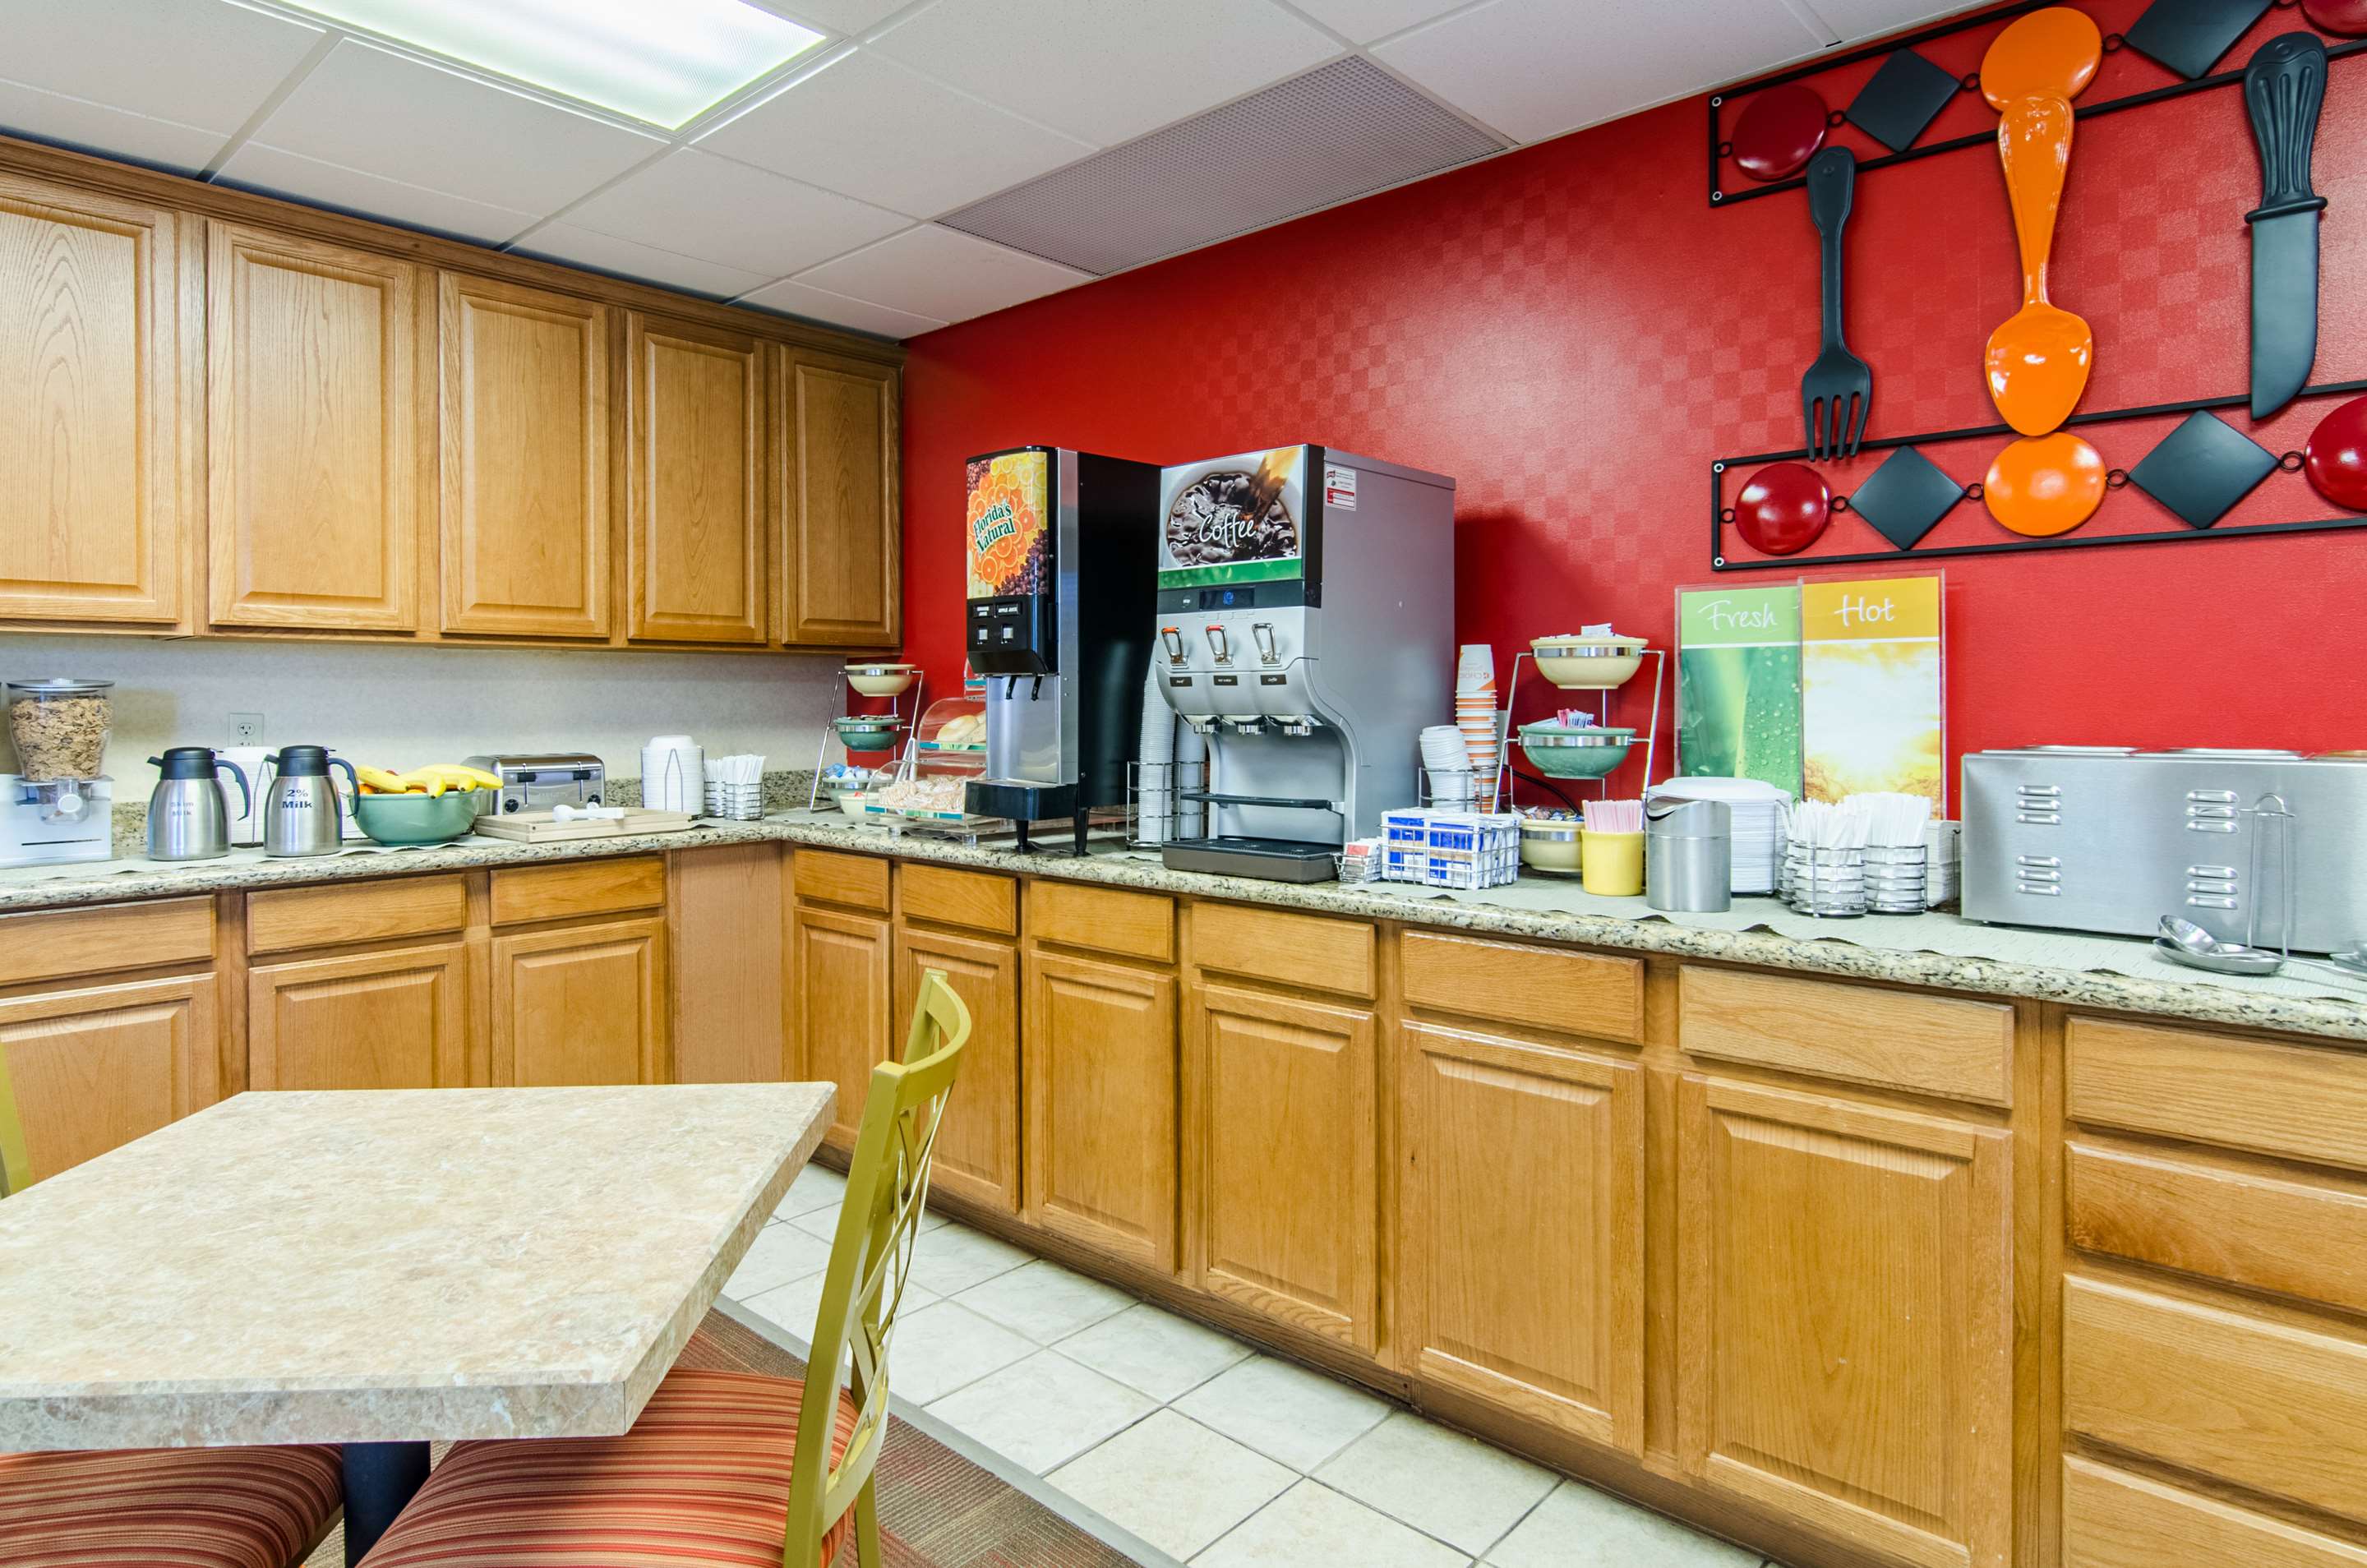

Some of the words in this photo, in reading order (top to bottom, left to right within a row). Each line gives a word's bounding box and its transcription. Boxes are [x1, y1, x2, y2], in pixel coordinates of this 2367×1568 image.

[973, 504, 1013, 538] Florida's
[976, 517, 1016, 554] Natural
[1199, 511, 1257, 548] Coffee
[1697, 599, 1779, 630] Fresh
[1834, 594, 1895, 627] Hot
[282, 800, 313, 809] Milk
[287, 789, 309, 797] 2%
